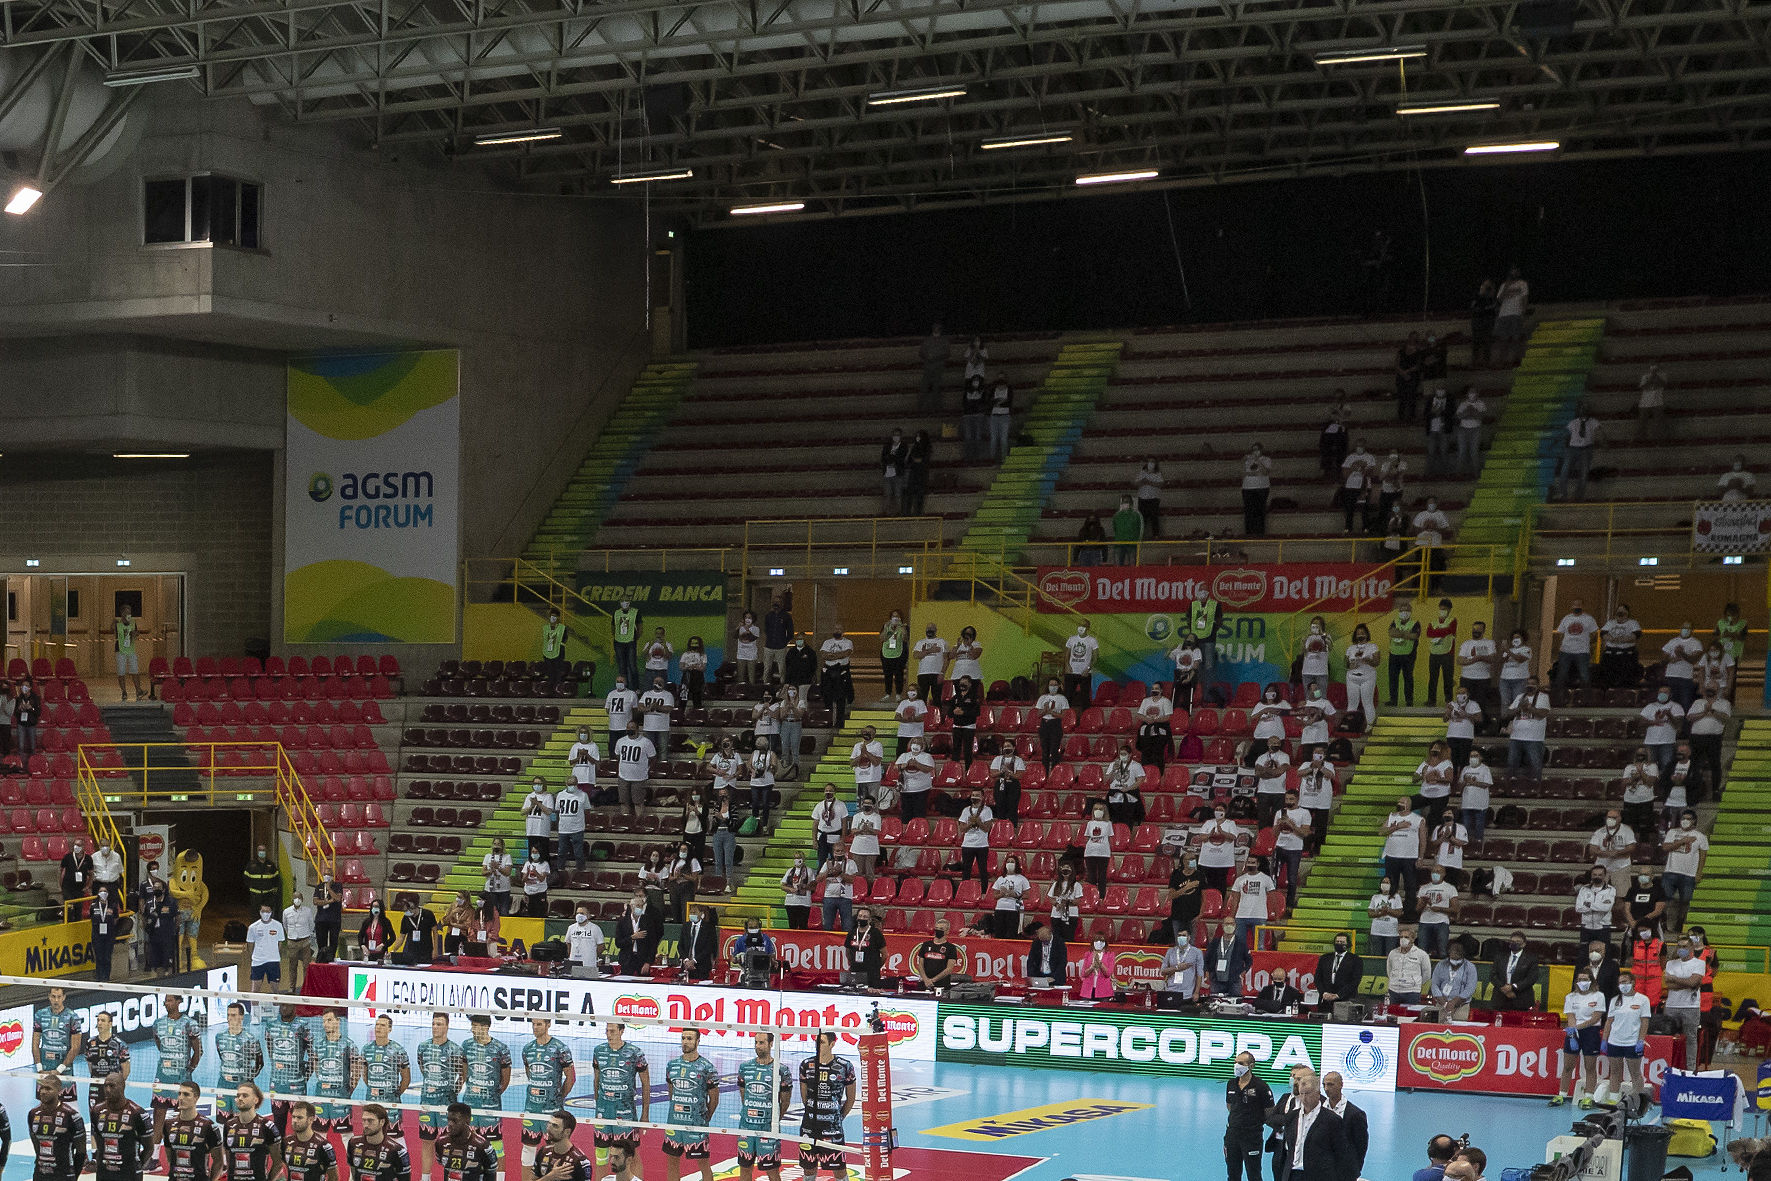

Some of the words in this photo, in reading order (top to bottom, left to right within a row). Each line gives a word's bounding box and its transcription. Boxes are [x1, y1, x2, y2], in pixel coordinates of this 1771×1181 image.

[339, 503, 433, 529] FORUM
[580, 585, 651, 602] CREDEM
[658, 585, 723, 602] BANCA
[1096, 578, 1131, 600] Del
[1273, 576, 1309, 599] Del
[1313, 576, 1391, 600] Monte
[1213, 643, 1265, 664] RUM
[621, 745, 641, 762] BIO
[559, 799, 578, 815] BIO
[25, 942, 96, 975] MIKASA
[784, 944, 821, 971] Del
[976, 952, 1015, 979] Del
[1117, 964, 1132, 977] Del
[386, 979, 416, 1014] LEGA
[420, 982, 490, 1018] PALLAVOLO
[493, 986, 570, 1025] SERIE
[578, 992, 597, 1027] A
[617, 1003, 631, 1015] Del
[631, 1004, 658, 1016] Monte
[666, 994, 725, 1037] Del
[733, 998, 861, 1046] Monte
[887, 1019, 917, 1033] Monte
[942, 1014, 1315, 1070] SUPERCOPPA
[1417, 1046, 1437, 1060] Del
[1438, 1047, 1478, 1062] Monte
[1431, 1060, 1461, 1072] Quality
[1495, 1044, 1549, 1079] Del
[532, 1064, 545, 1073] SIR
[606, 1070, 619, 1078] SIR
[861, 1059, 869, 1089] Monte
[877, 1059, 886, 1089] Monte
[819, 1071, 827, 1081] 18
[605, 1083, 628, 1091] CONAD
[675, 1079, 689, 1089] SIR
[751, 1083, 765, 1093] SIR
[877, 1089, 886, 1102] Del
[1677, 1091, 1724, 1104] MIKASA
[748, 1101, 772, 1109] CONAD
[108, 1121, 116, 1132] 13
[963, 1104, 1140, 1138] MIKASA
[43, 1124, 48, 1135] 9
[179, 1134, 188, 1145] 10
[239, 1136, 245, 1147] 11
[293, 1155, 301, 1166] 15
[364, 1158, 375, 1169] 22
[451, 1157, 462, 1169] 23
[880, 1155, 889, 1168] Del
